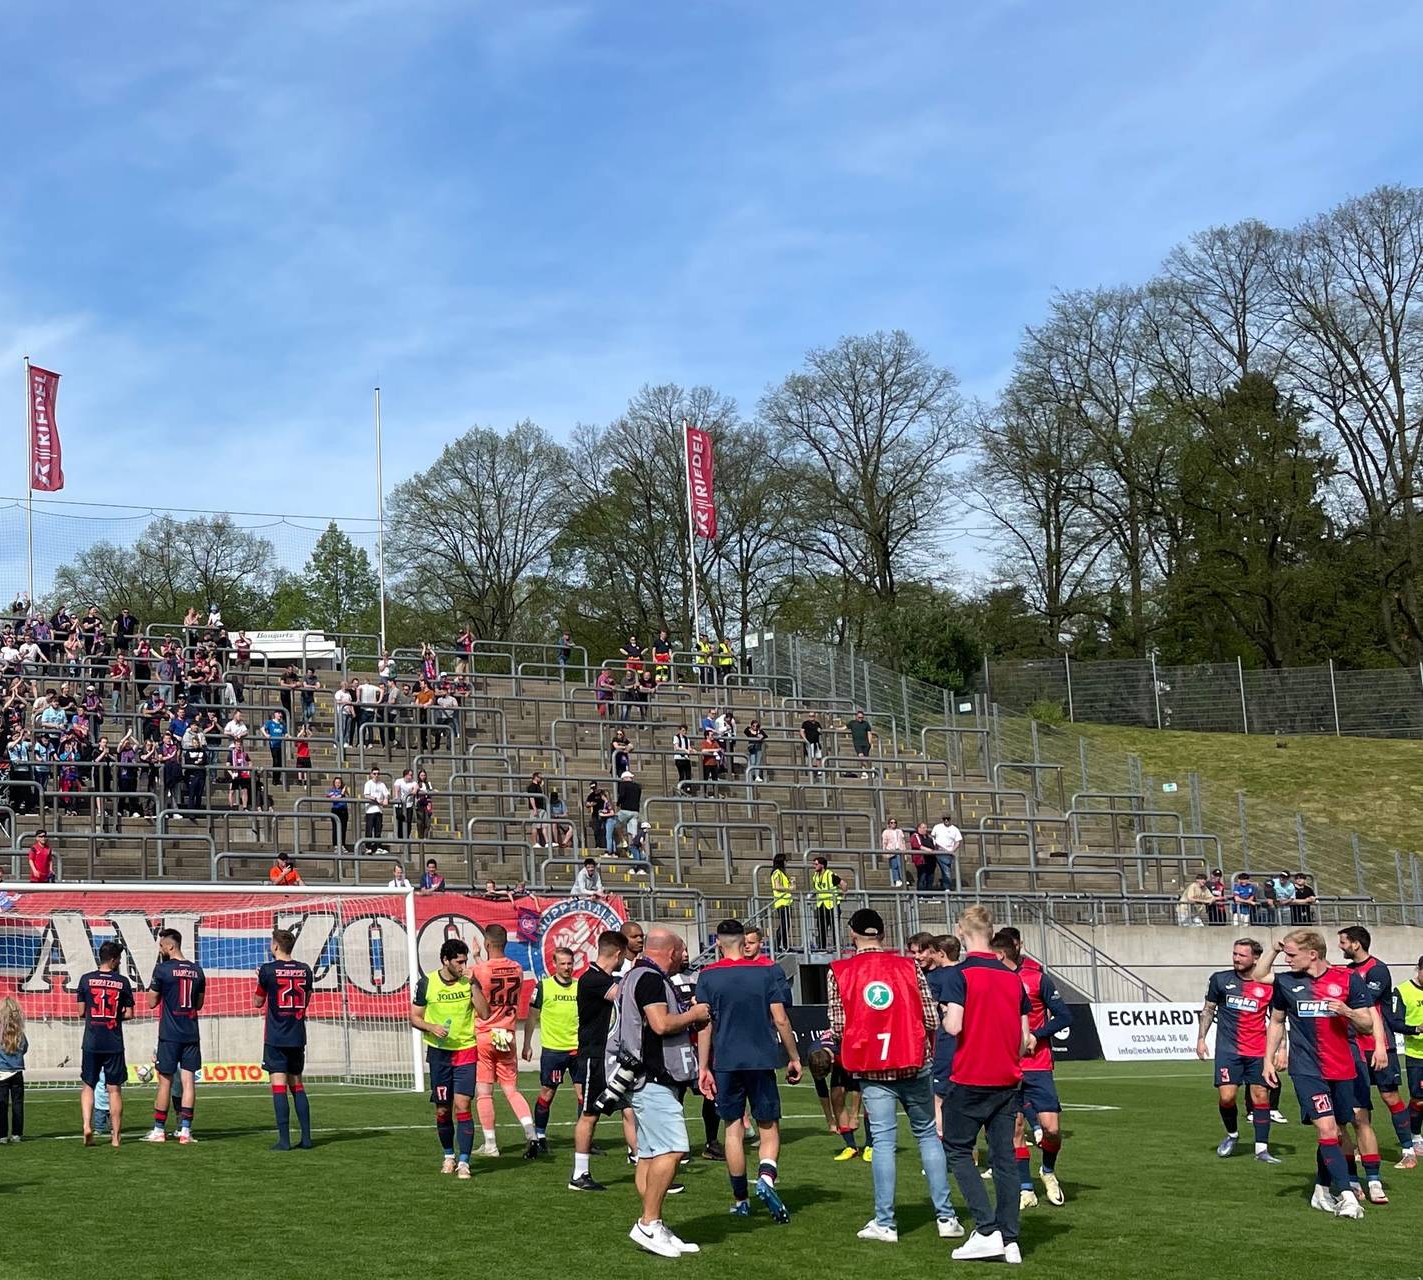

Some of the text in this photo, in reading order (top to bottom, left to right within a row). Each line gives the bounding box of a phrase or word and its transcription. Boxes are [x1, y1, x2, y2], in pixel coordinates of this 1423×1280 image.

[90, 987, 120, 1019] 33
[178, 977, 194, 1009] 11
[276, 977, 307, 1009] 25
[489, 976, 521, 1007] 22
[1108, 1010, 1201, 1027] ECKHARDT
[876, 1032, 892, 1061] 7
[203, 1065, 263, 1081] LOTTO
